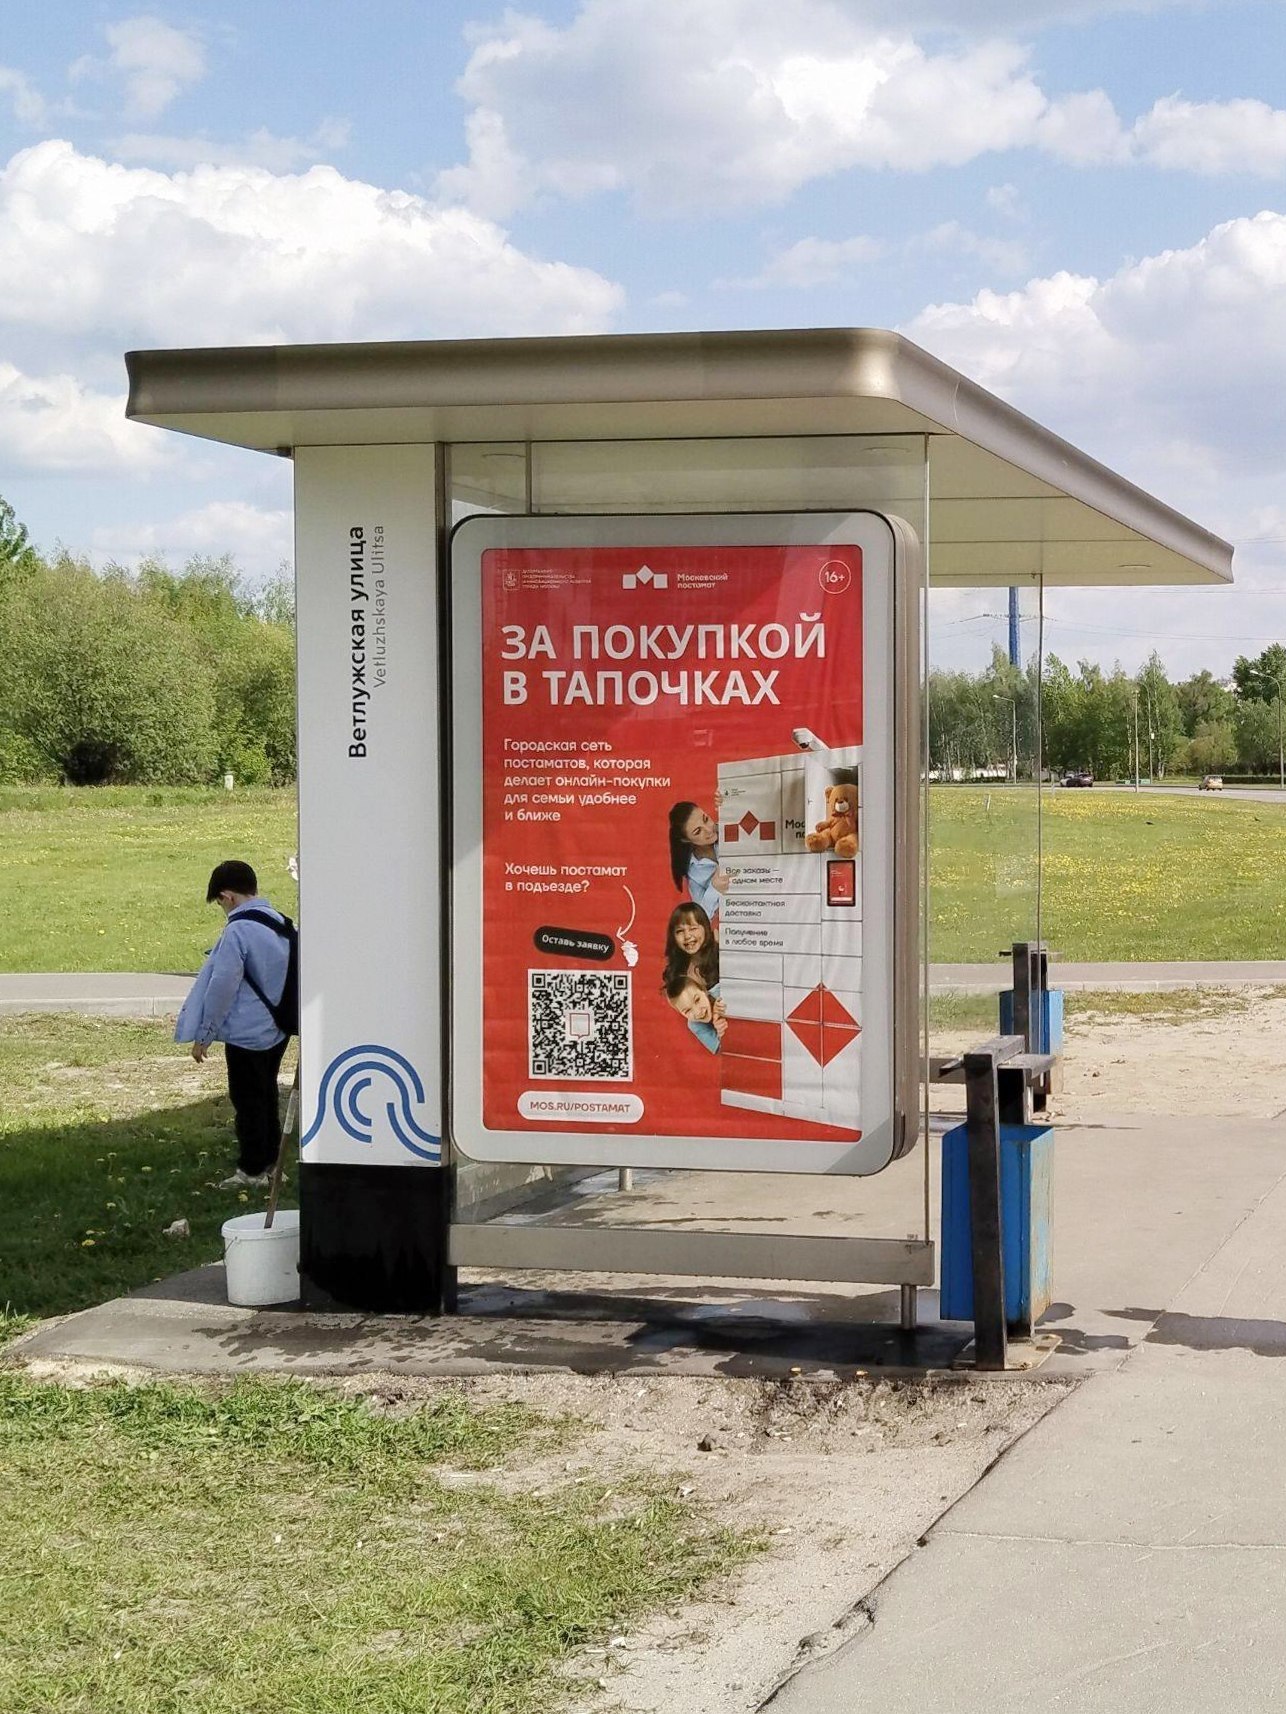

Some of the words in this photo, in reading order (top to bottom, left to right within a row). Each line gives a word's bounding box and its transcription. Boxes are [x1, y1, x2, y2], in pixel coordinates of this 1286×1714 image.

[371, 525, 384, 574] Ulitsa
[349, 526, 369, 602] улица
[677, 573, 728, 582] Московский
[824, 571, 846, 583] 16+
[371, 579, 389, 688] Vetluzhskaya
[501, 625, 557, 660] ЗА
[574, 612, 826, 660] ПОКУПКОЙ
[348, 608, 370, 758] Ветлужская
[503, 671, 528, 706] В
[543, 670, 781, 706] ТАПОЧКАХ
[504, 738, 577, 754] Городская
[581, 740, 612, 752] сеть
[504, 759, 590, 771] постаматов,
[593, 759, 651, 771] которая
[504, 776, 552, 787] делает
[555, 774, 671, 789] онлайн-покупки
[504, 793, 528, 805] для
[532, 794, 575, 804] семьи
[578, 792, 637, 806] удобнее
[504, 811, 514, 821] и
[517, 809, 562, 821] ближе
[505, 862, 557, 876] Хочешь
[560, 865, 627, 877] постамат
[505, 881, 513, 891] в
[517, 880, 590, 894] подъезде?
[725, 899, 785, 907] Бесконтактная
[725, 928, 768, 936] Получение
[541, 934, 576, 947] Оставь
[576, 941, 610, 953] заявку
[732, 938, 757, 946] любое
[530, 1101, 631, 1113] MOS.RU/POSTAMAT
